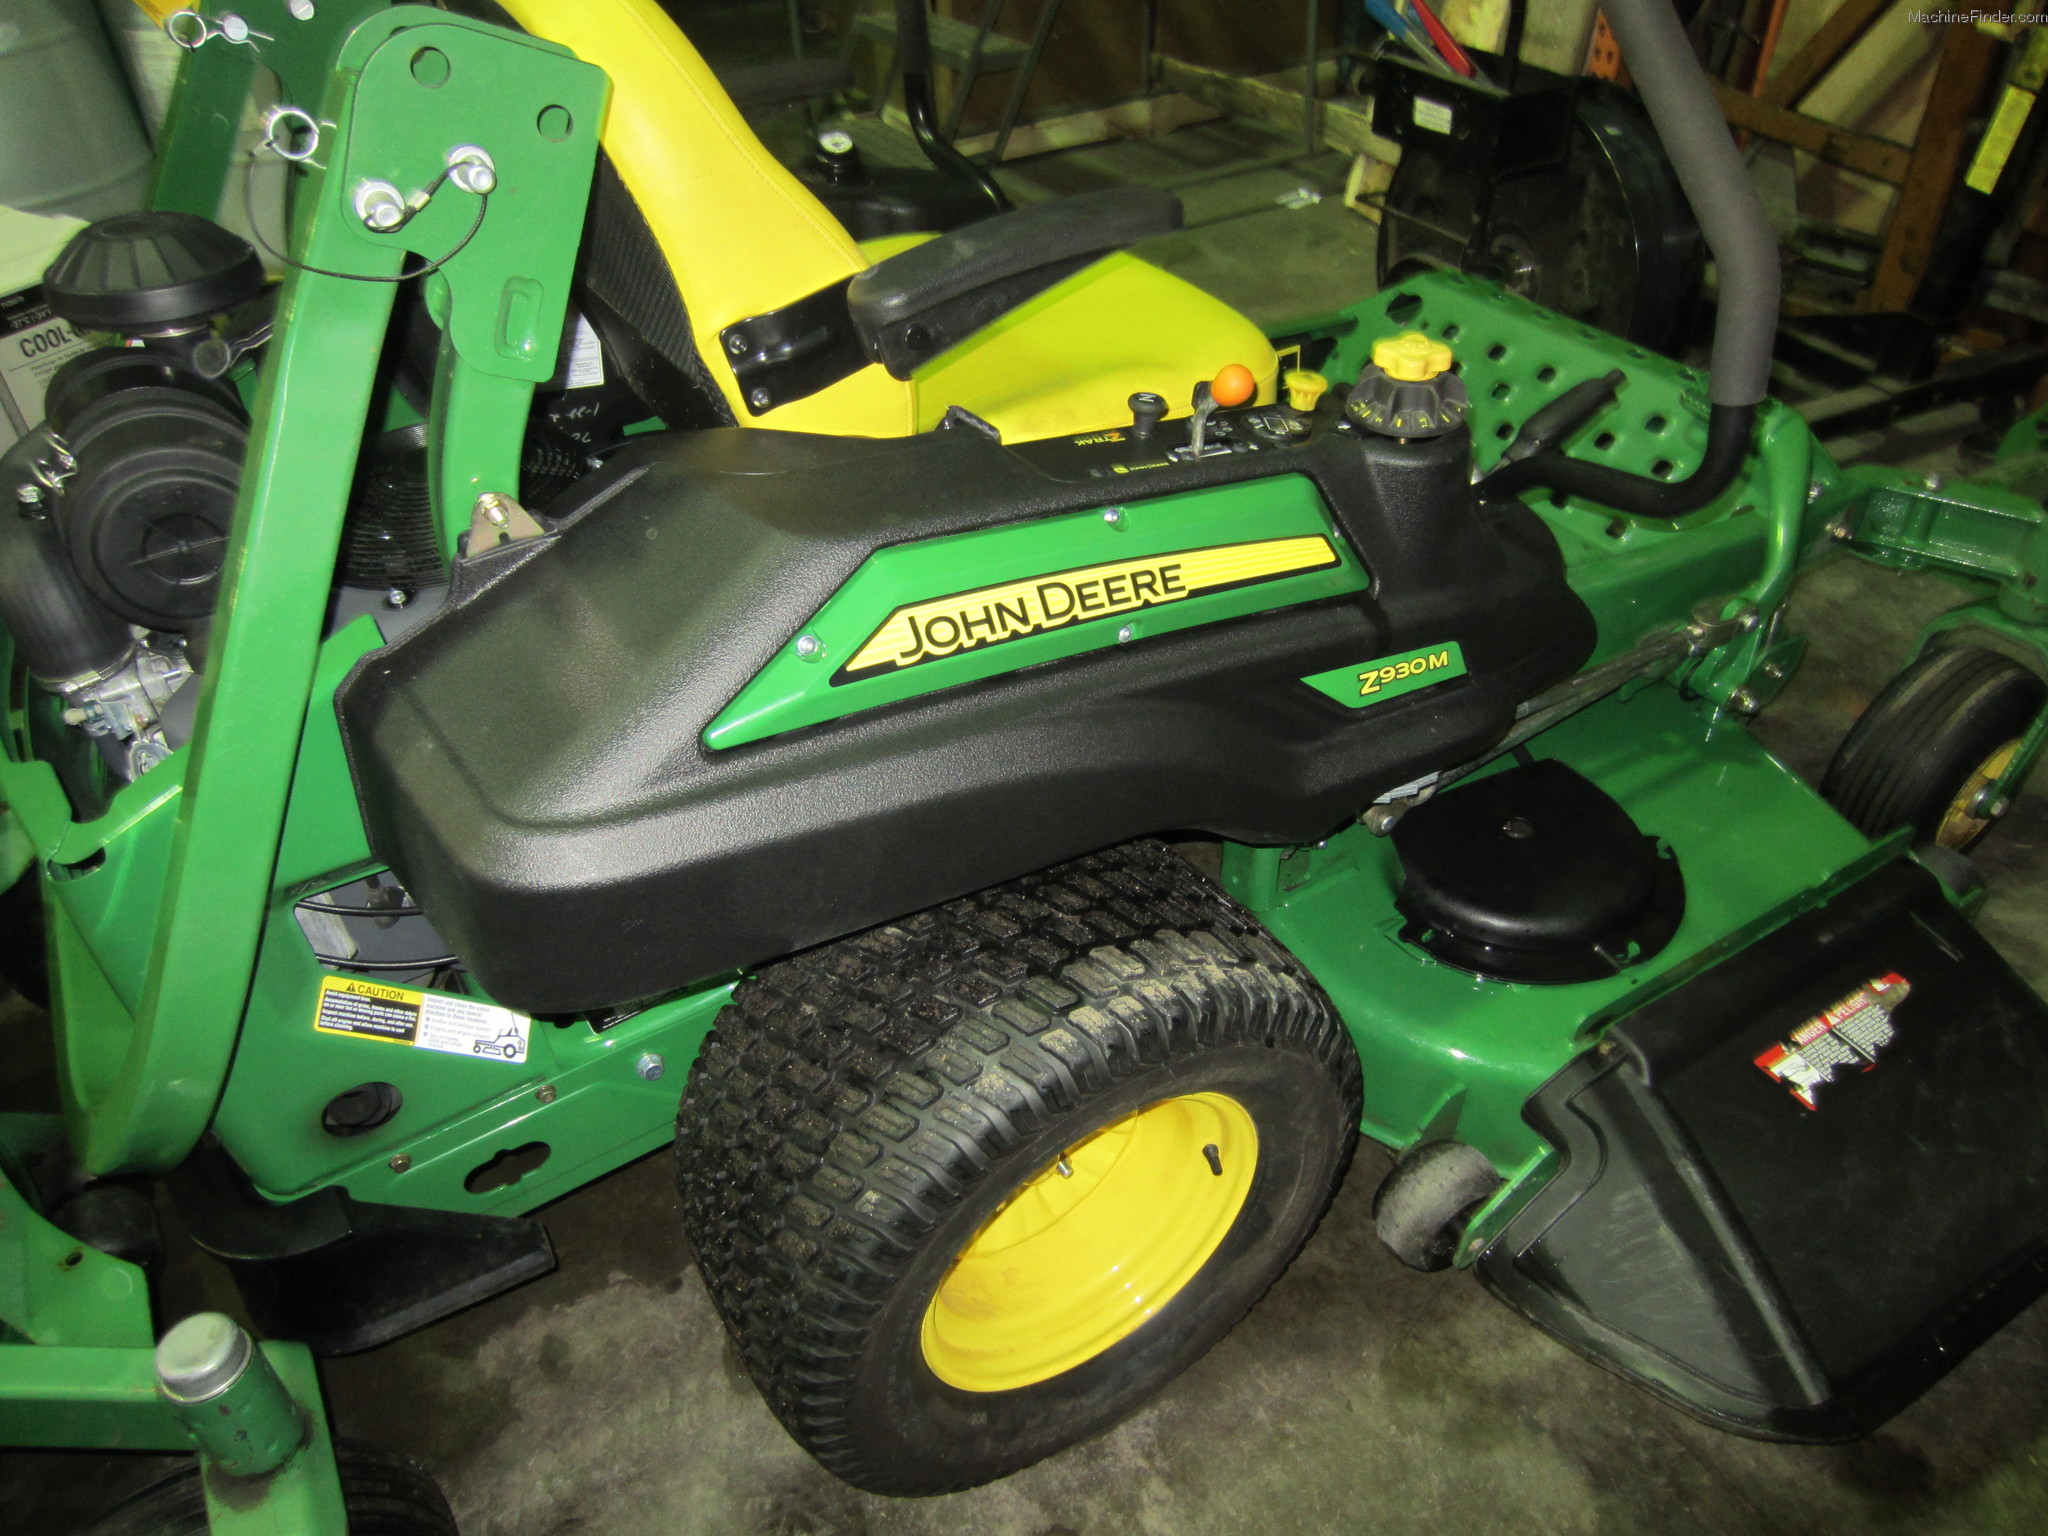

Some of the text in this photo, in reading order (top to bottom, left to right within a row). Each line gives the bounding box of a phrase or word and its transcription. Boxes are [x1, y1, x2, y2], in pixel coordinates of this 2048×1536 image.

[899, 564, 1187, 658] JOHN DEERE
[1358, 650, 1449, 696] Z930M
[357, 984, 404, 1000] CAUTION
[1797, 1021, 1827, 1045] ANGER
[1835, 992, 1868, 1019] PELIGR
